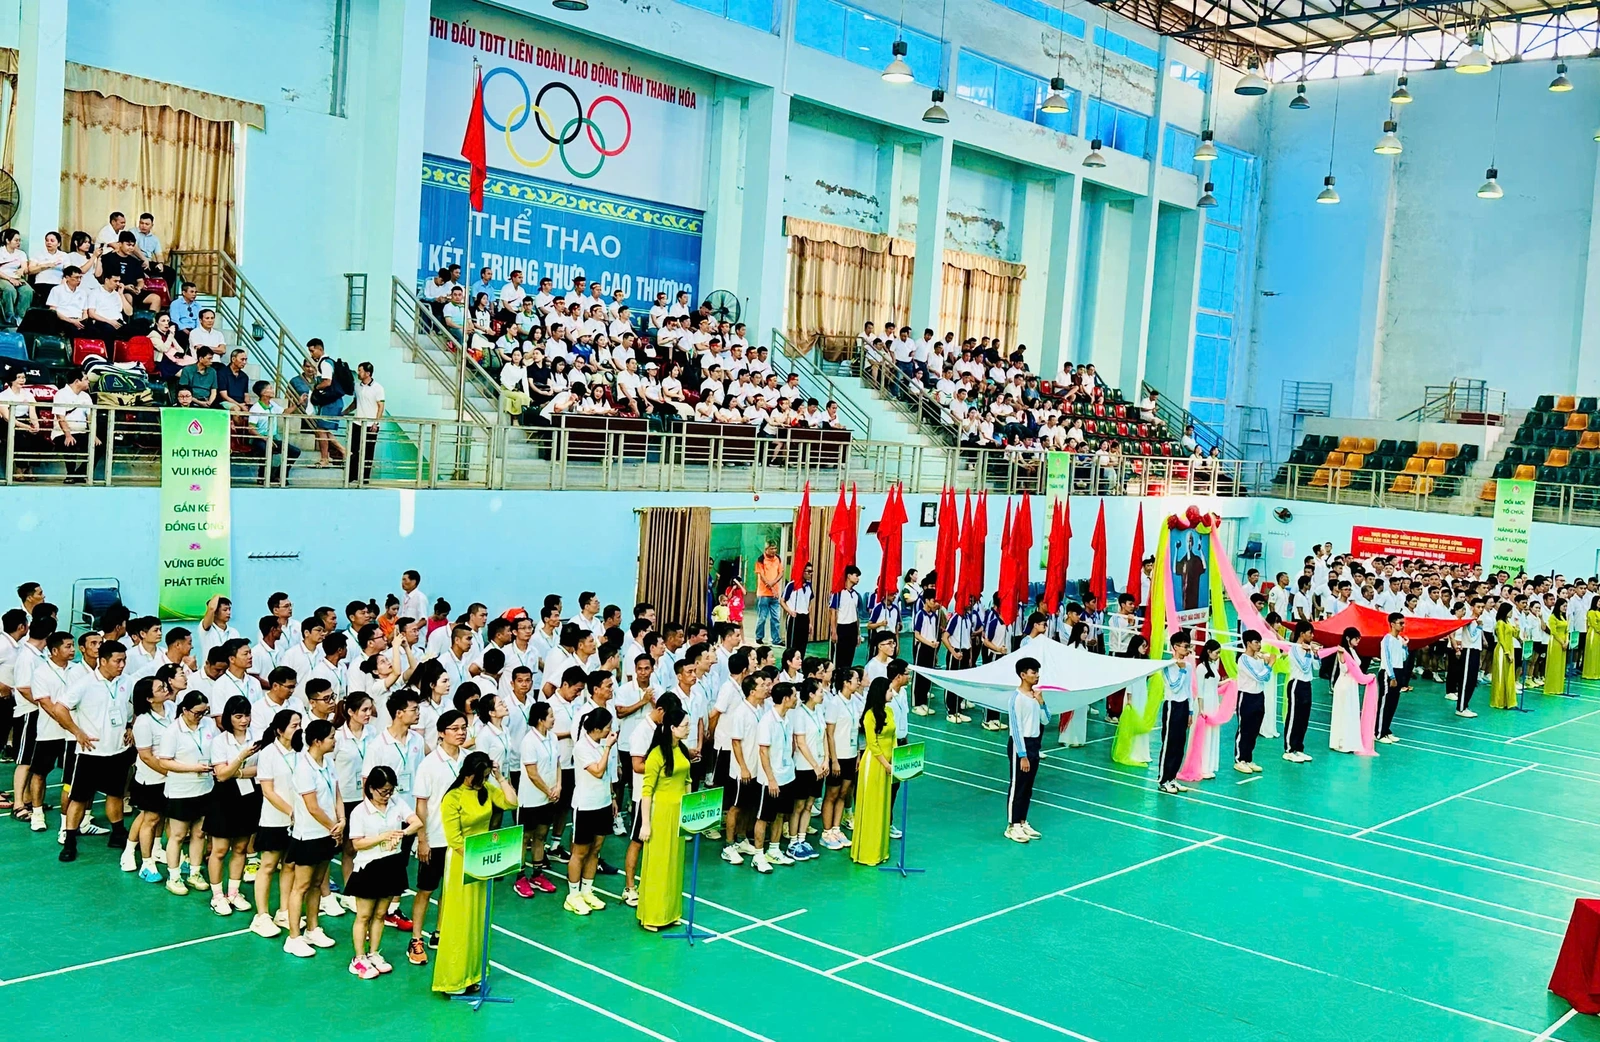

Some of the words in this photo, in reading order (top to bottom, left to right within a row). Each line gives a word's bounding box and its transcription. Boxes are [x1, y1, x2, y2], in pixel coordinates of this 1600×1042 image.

[430, 16, 448, 40] THI
[451, 19, 476, 48] ĐẤU
[479, 30, 506, 56] TDTT
[508, 38, 534, 64] LIÊN
[536, 48, 567, 73] ĐOÀN
[568, 56, 588, 80] LAO
[591, 61, 619, 88] ĐỘNG
[621, 66, 643, 95] TỈNH
[646, 78, 676, 104] THANH
[678, 87, 697, 109] HÓA
[472, 208, 532, 245] THỂ
[541, 223, 622, 259] THAO
[428, 237, 463, 272] KẾT
[481, 252, 539, 287] TRUNG
[601, 270, 632, 299] CAO
[172, 447, 190, 459] HỘI
[192, 449, 218, 458] THAO
[171, 467, 190, 476] VUI
[197, 556, 224, 568] BƯỚC
[164, 576, 193, 587] PHÁT
